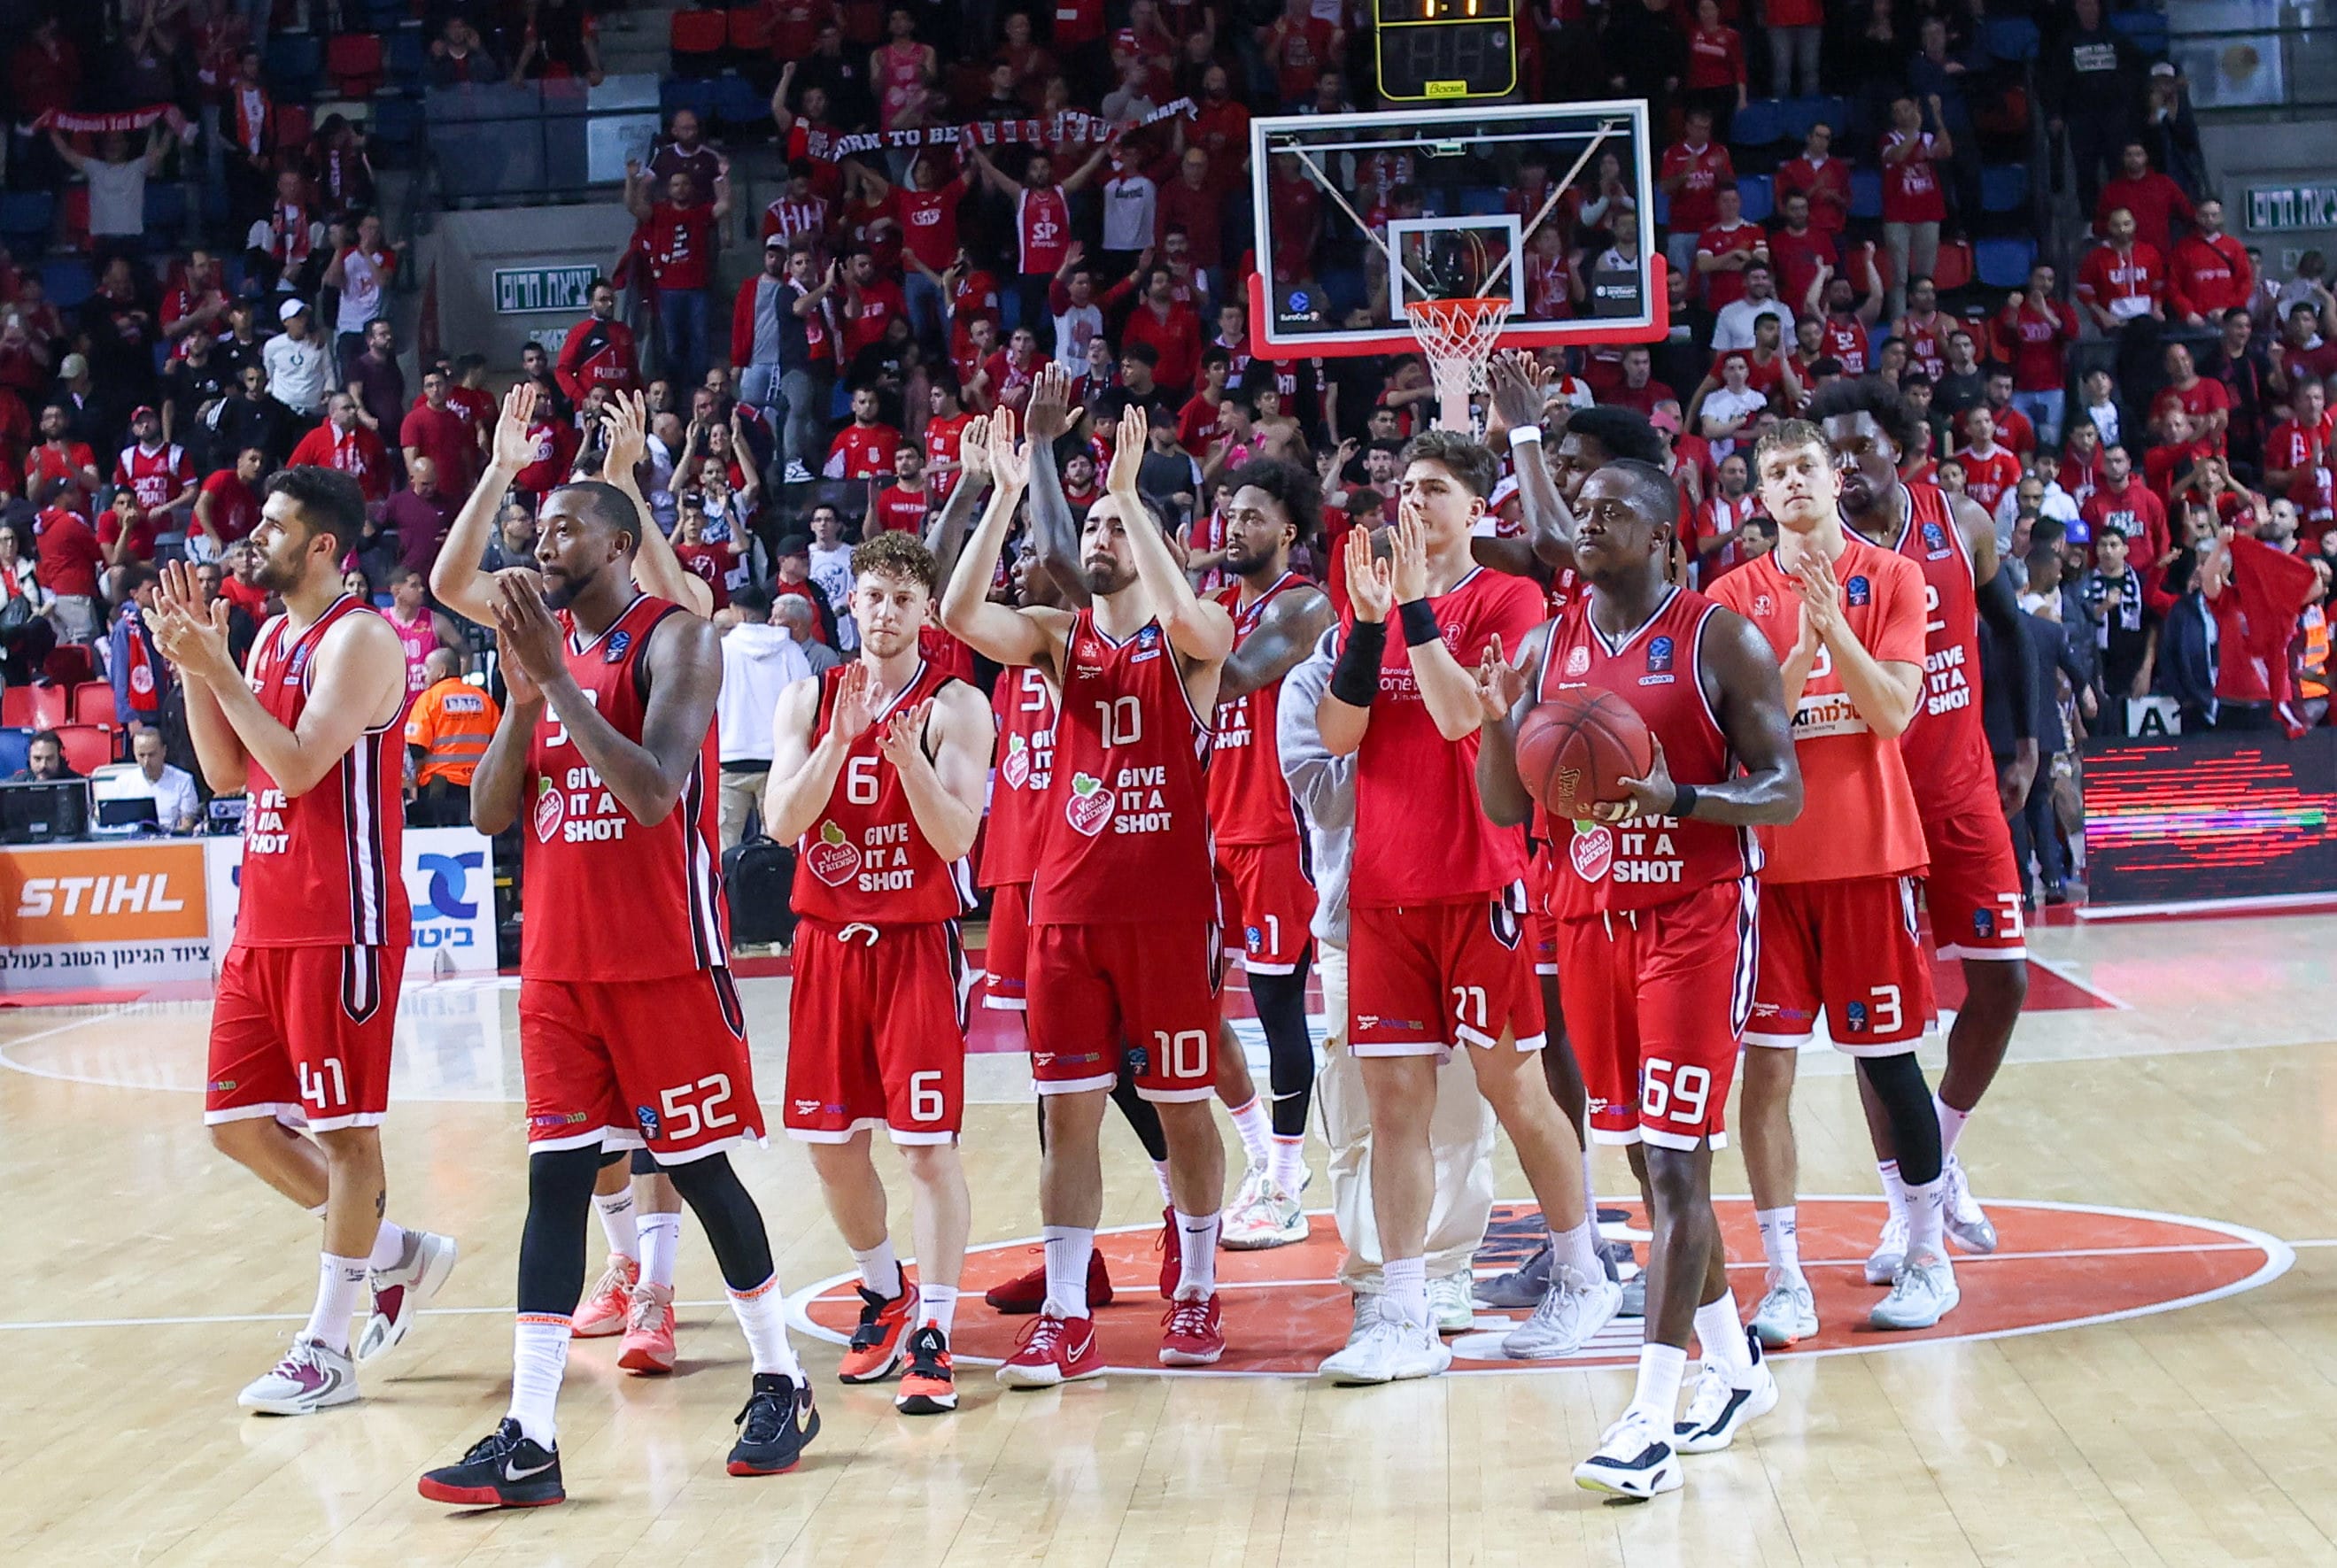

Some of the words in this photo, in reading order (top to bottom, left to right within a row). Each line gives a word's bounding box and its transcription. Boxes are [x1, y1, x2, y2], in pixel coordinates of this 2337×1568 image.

[888, 130, 920, 146] TO
[930, 127, 960, 143] BE
[501, 273, 540, 308] חרום
[1925, 645, 1966, 672] GIVE
[1931, 674, 1948, 694] IT
[1950, 668, 1967, 688] A
[1927, 686, 1971, 716] SHOT
[1095, 695, 1141, 749] 10
[2139, 707, 2169, 735] A
[1034, 751, 1054, 770] IT
[567, 767, 603, 790] GIV
[847, 756, 879, 805] 6
[1117, 766, 1166, 788] GIVE
[569, 793, 591, 816] IT
[597, 792, 619, 815] A
[1074, 799, 1112, 827] FRIENDLY
[1076, 793, 1107, 815] VEGAN
[1122, 791, 1144, 811] IT
[1148, 790, 1165, 809] A
[563, 817, 627, 843] SHOT
[864, 823, 909, 846] GIVE
[1114, 812, 1172, 834] SHOT
[1578, 839, 1611, 871] FRIENDLY
[1579, 832, 1607, 856] VEGAN
[1621, 833, 1647, 856] IT
[1653, 833, 1675, 855] A
[865, 849, 886, 869] IT
[892, 846, 909, 867] A
[858, 869, 915, 892] SHOT
[1613, 860, 1684, 883] SHOT
[17, 873, 185, 917] STIHL
[1264, 914, 1280, 956] 1
[60, 951, 106, 968] הטוב
[113, 947, 165, 969] הגינון
[170, 945, 211, 963] ציוד
[1870, 985, 1903, 1034] 3
[1154, 1030, 1208, 1078] 10
[299, 1057, 347, 1109] 41
[910, 1070, 944, 1122] 6
[1642, 1057, 1711, 1125] 69
[660, 1073, 738, 1140] 52
